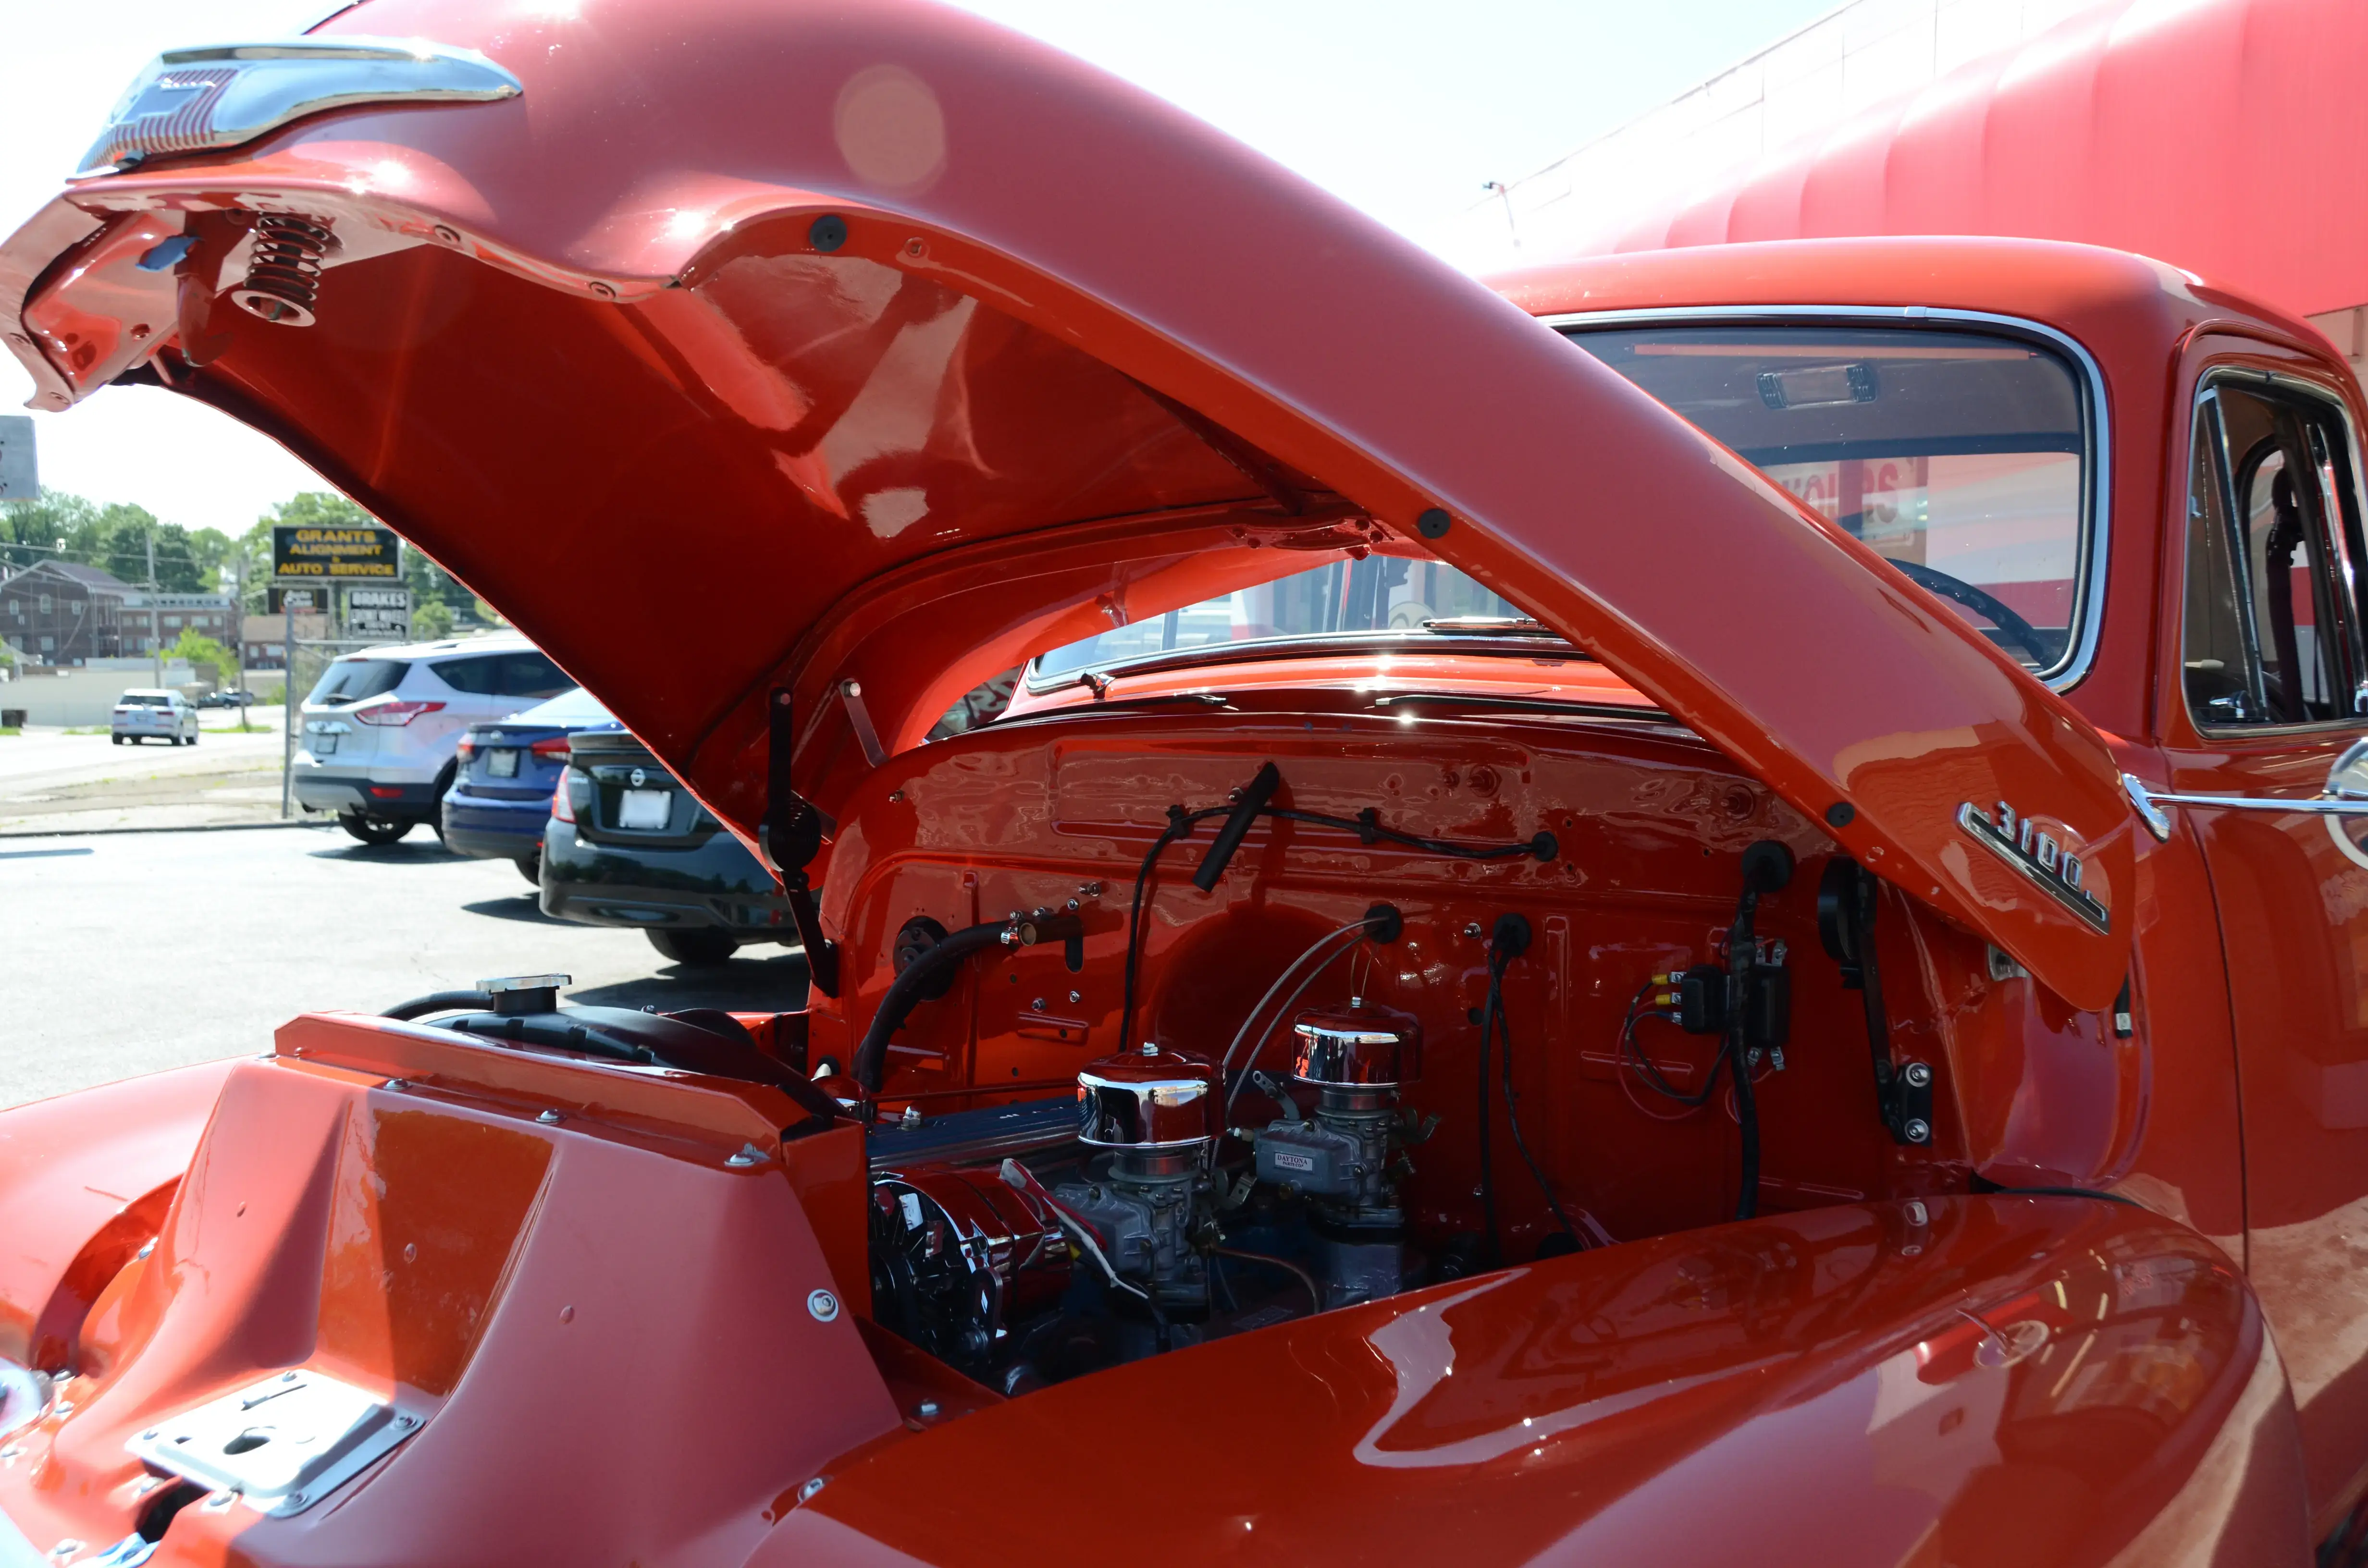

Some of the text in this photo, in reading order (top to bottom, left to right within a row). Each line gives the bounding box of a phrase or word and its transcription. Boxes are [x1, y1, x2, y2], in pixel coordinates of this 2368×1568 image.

[295, 529, 376, 542] GRANTS
[290, 543, 383, 555] ALIGNMENT
[278, 563, 395, 576] AUTO SERVICE
[1997, 801, 2083, 892] 3100
[1277, 1154, 1308, 1165] DAYTONA
